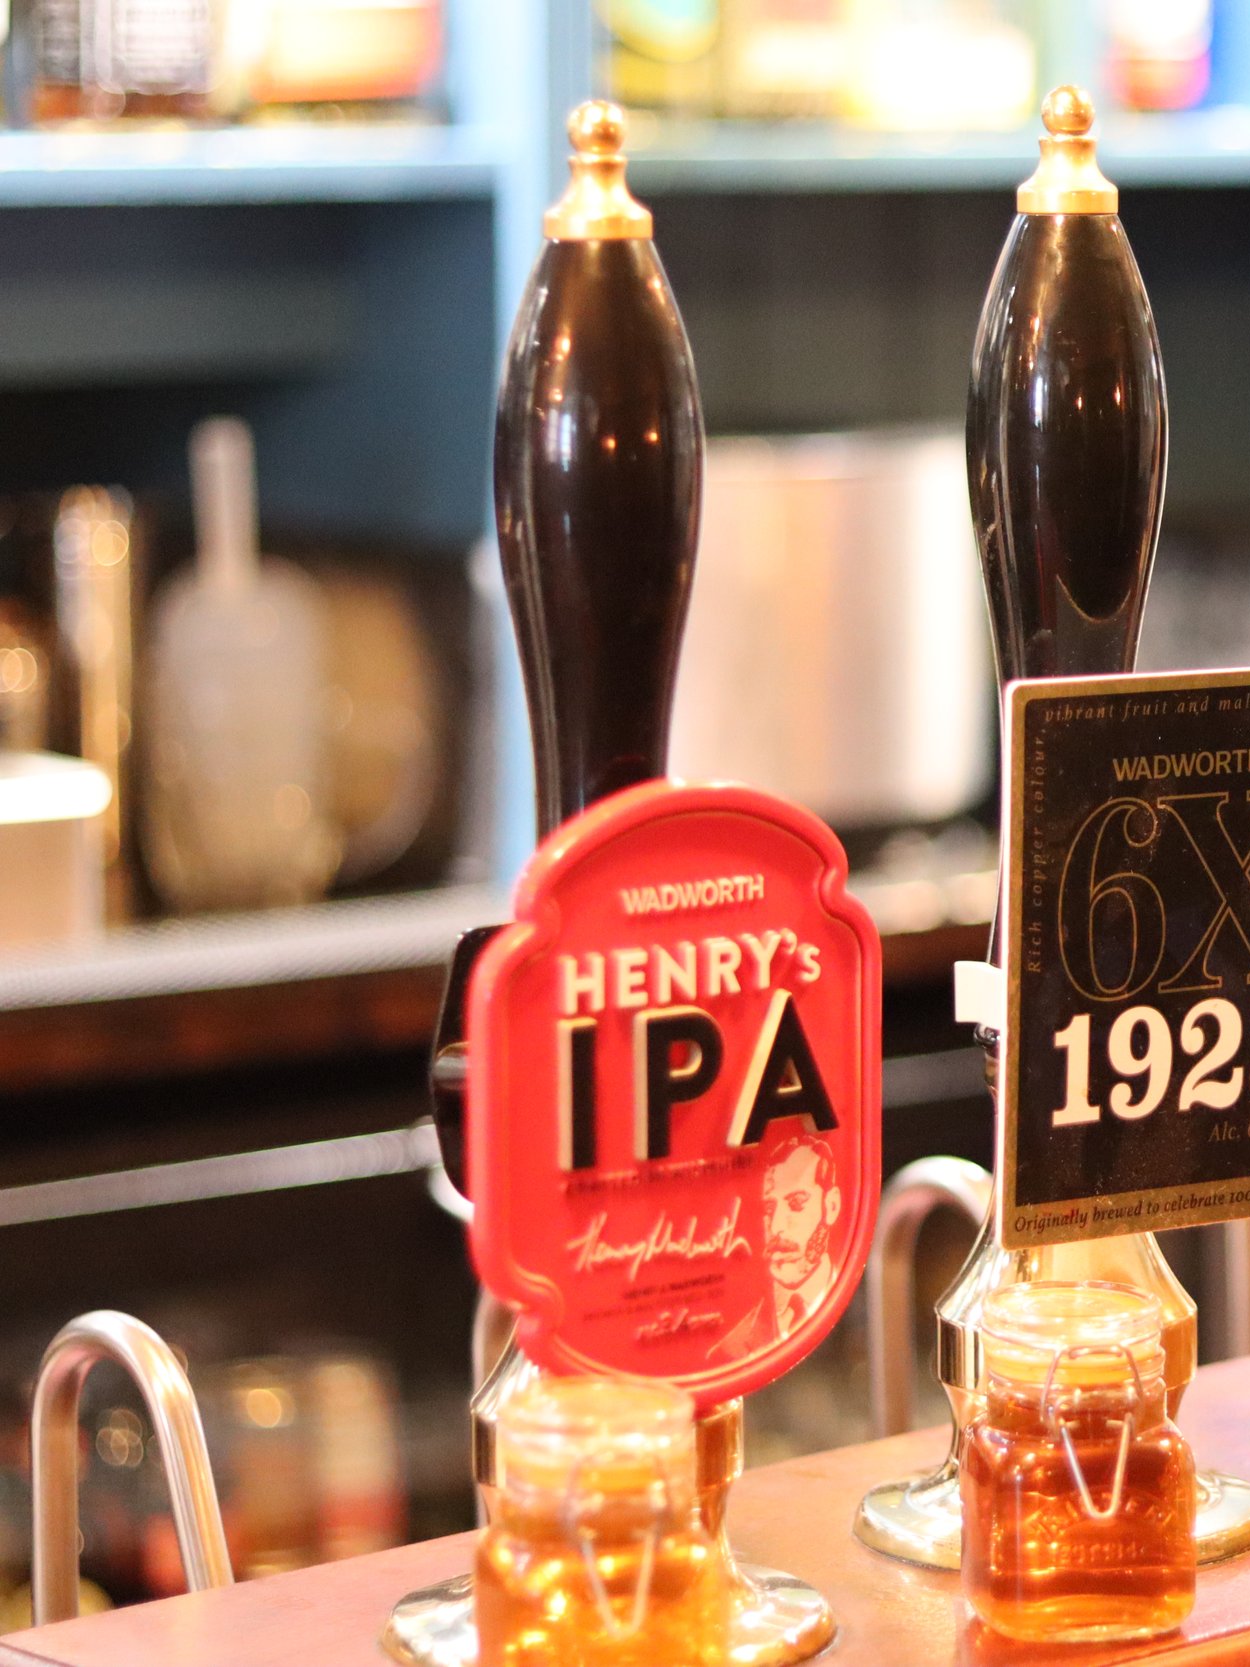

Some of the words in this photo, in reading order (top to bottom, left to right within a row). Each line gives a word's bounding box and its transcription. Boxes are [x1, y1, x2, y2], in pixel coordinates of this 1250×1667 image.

[1044, 703, 1114, 722] vibrant
[1120, 699, 1167, 722] fruit
[1176, 695, 1209, 713] and
[1031, 826, 1048, 908] copper
[620, 875, 765, 915] WADWORTH
[1027, 919, 1043, 974] Rich
[556, 989, 840, 1173] IPA
[1209, 1121, 1240, 1143] Alc.
[1015, 1207, 1088, 1234] Originally
[1092, 1201, 1142, 1221] brewed
[1146, 1203, 1160, 1214] to
[1163, 1192, 1225, 1213] celebrate
